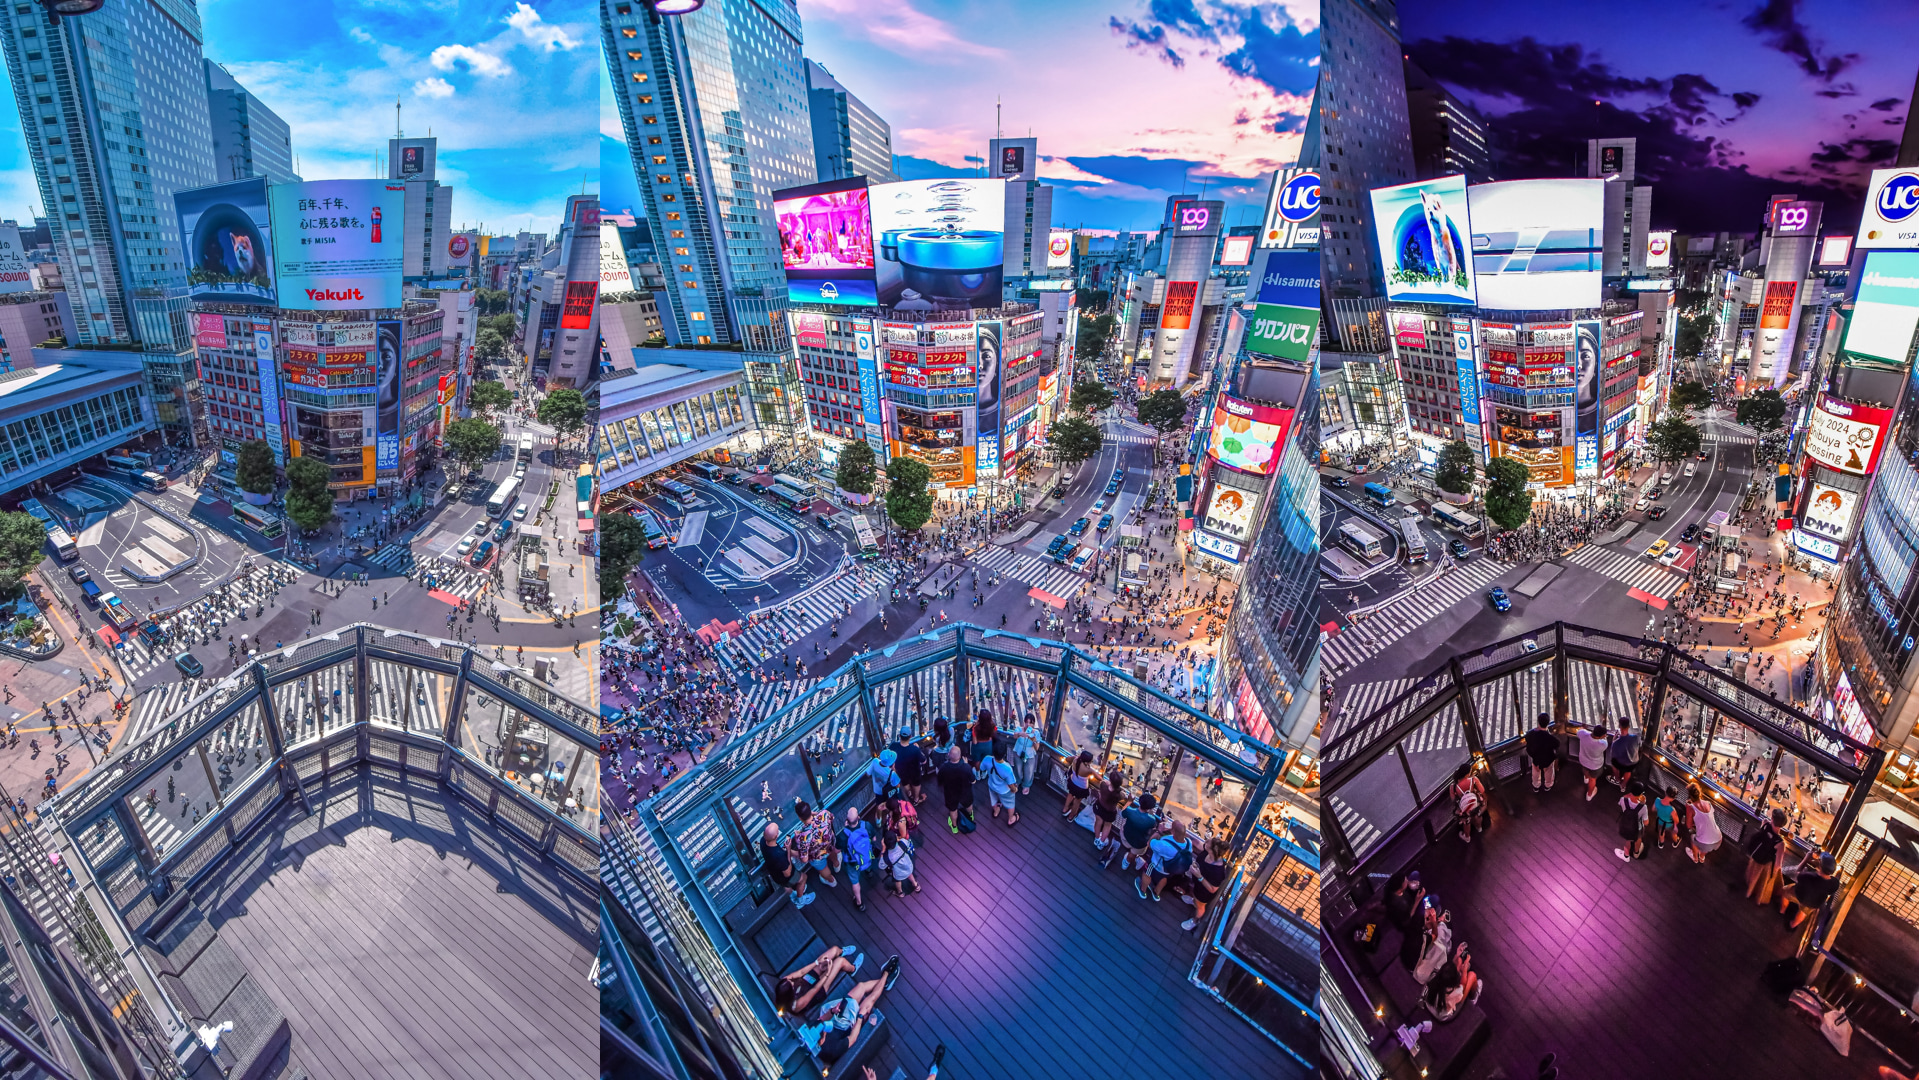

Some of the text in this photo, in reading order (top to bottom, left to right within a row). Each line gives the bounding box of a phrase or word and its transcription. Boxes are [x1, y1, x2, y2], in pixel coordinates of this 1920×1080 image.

[298, 198, 349, 211] 百年、千年、
[300, 217, 365, 229] 心に残る歌を。
[1182, 207, 1209, 230] 109
[1780, 208, 1808, 231] 109
[305, 288, 364, 301] Yakult
[568, 282, 596, 298] WINNING
[1168, 283, 1196, 298] WINNING
[1767, 283, 1795, 297] WINNING
[1254, 318, 1311, 345] サロンパス
[326, 353, 365, 362] コンタクト
[926, 354, 965, 362] コンタクト
[1525, 353, 1564, 362] コンタクト
[906, 366, 920, 375] ガスト
[953, 366, 971, 375] ガスト
[1505, 366, 1520, 375] ガスト
[1552, 367, 1571, 375] ガスト
[300, 374, 318, 386] ガスト
[901, 375, 917, 385] ガスト
[1500, 375, 1516, 385] ガスト
[260, 368, 271, 413] アイシティ
[860, 368, 871, 413] アイシティ
[1459, 368, 1470, 413] アイシティ
[1827, 419, 1850, 434] 2024
[1810, 424, 1841, 449] Shibuya
[378, 441, 397, 459] 勝ち
[978, 441, 998, 459] 勝ち
[1577, 441, 1596, 459] 勝ち
[1808, 437, 1843, 465] Crossing
[1206, 516, 1244, 535] DMM
[1805, 516, 1843, 535] DMM
